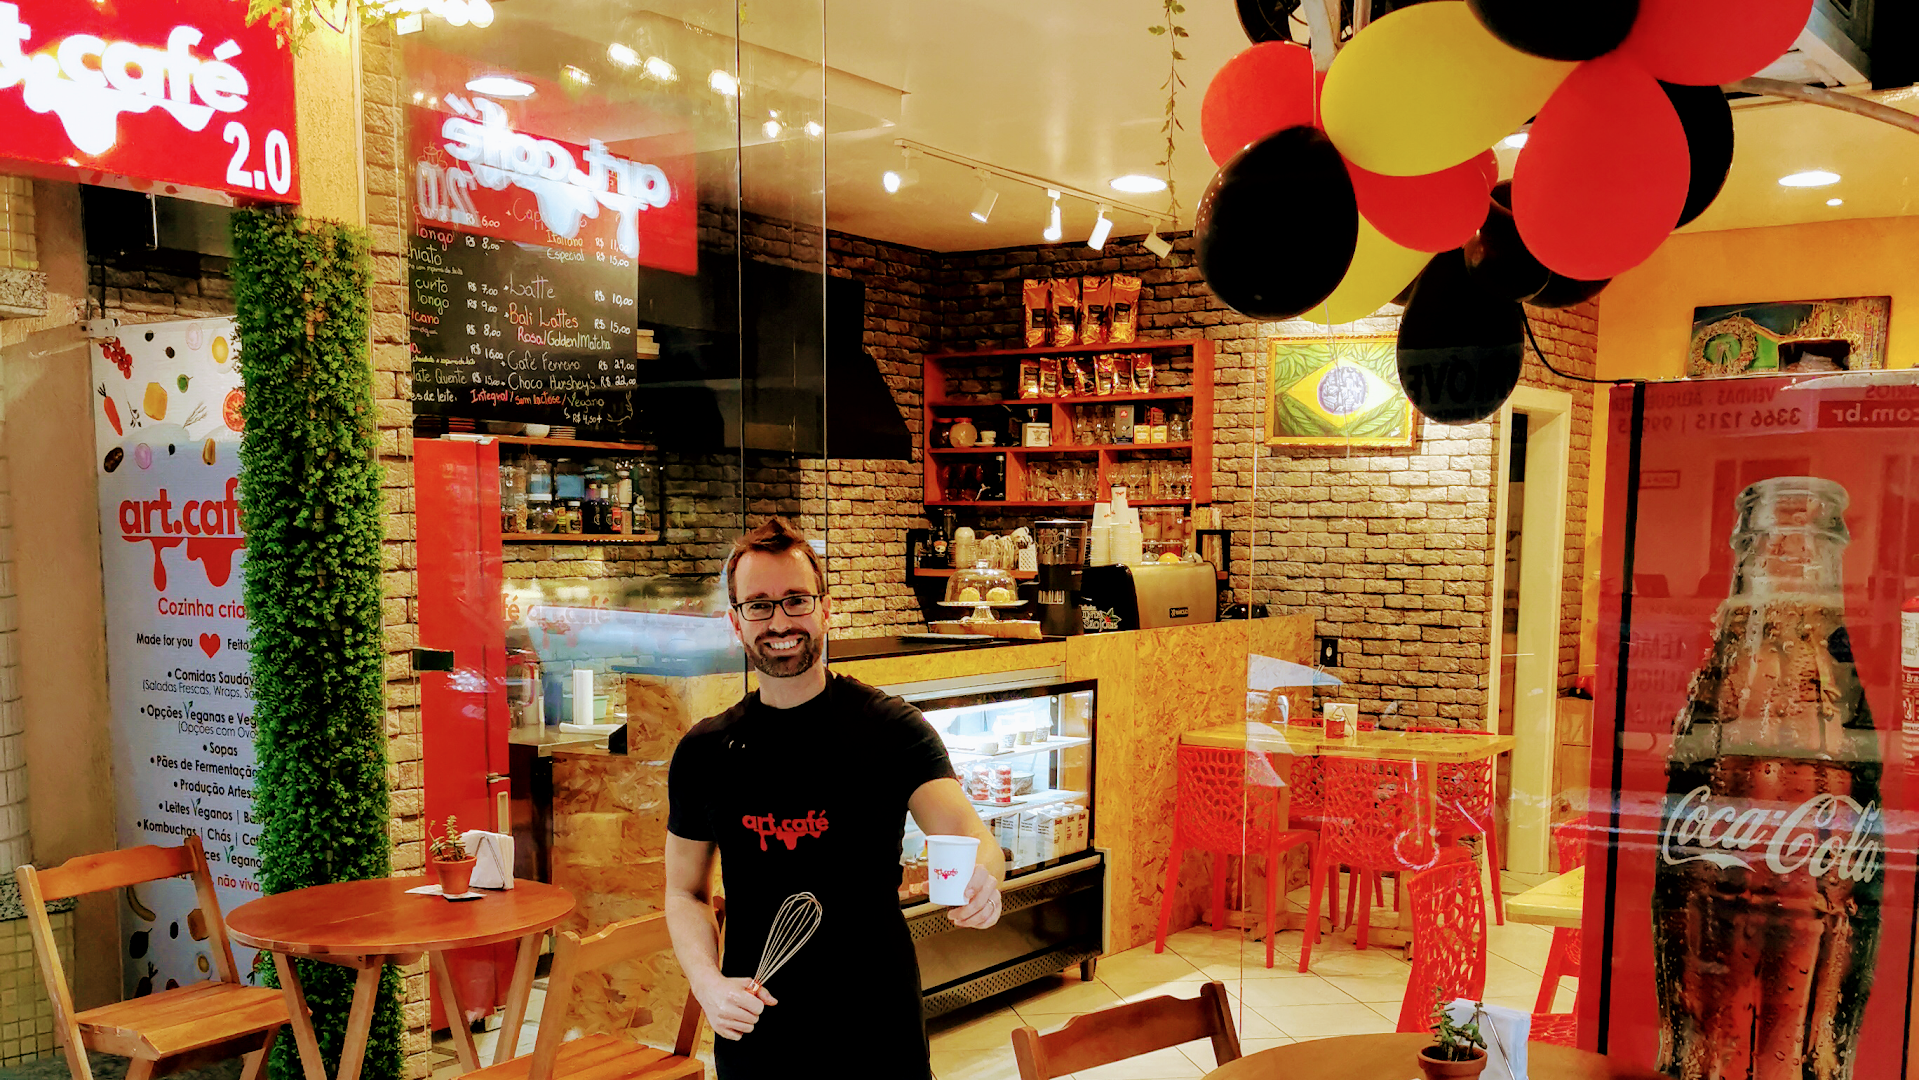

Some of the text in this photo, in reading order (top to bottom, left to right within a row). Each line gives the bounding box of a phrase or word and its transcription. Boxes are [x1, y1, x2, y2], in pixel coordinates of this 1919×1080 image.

[222, 121, 291, 194] 2.0
[481, 215, 500, 228] 6,00
[408, 239, 443, 266] hiato
[465, 235, 476, 248] R$
[481, 237, 500, 251] 8,00
[595, 237, 605, 249] R$
[546, 248, 630, 268] Especial R$ 15,00
[415, 277, 498, 296] curto R$ 7,00
[509, 273, 634, 307] Latte R$ 10,00
[417, 288, 498, 315] longo R$ 9,00
[509, 302, 631, 335] Bali Lattes R$ 15,00
[466, 324, 476, 336] R$
[483, 323, 501, 337] 8,00
[470, 342, 504, 359] R$ 16,00
[507, 350, 538, 371] Café
[542, 351, 580, 371] Ferrero
[598, 359, 609, 371] R$
[435, 367, 468, 385] Quente
[471, 371, 482, 384] R$
[485, 375, 500, 386] 15,00
[507, 372, 543, 391] Choco
[600, 375, 612, 388] R$
[615, 374, 637, 386] 22,00
[119, 477, 248, 535] art.caf
[158, 597, 248, 619] Cozinha cria
[136, 632, 249, 651] Made for you Feito
[174, 669, 216, 683] Comidas
[142, 679, 177, 693] (Saladas
[178, 679, 212, 696] Frescas,
[213, 686, 242, 699] Wraps,
[147, 705, 183, 720] Opções
[182, 700, 226, 724] Veganas
[228, 715, 234, 724] e
[178, 720, 214, 736] (Opções
[216, 727, 235, 737] com
[209, 741, 238, 758] Sopas
[156, 755, 178, 769] Pães
[180, 756, 193, 771] de
[180, 779, 225, 797] Produção
[165, 801, 190, 815] Leites
[191, 798, 233, 821] Veganos
[143, 818, 197, 837] Kombuchas
[207, 828, 231, 843] Chás
[742, 809, 829, 832] art.café
[1661, 785, 1880, 884] Coca-Cola
[224, 845, 264, 869] Vegano
[217, 873, 237, 888] não
